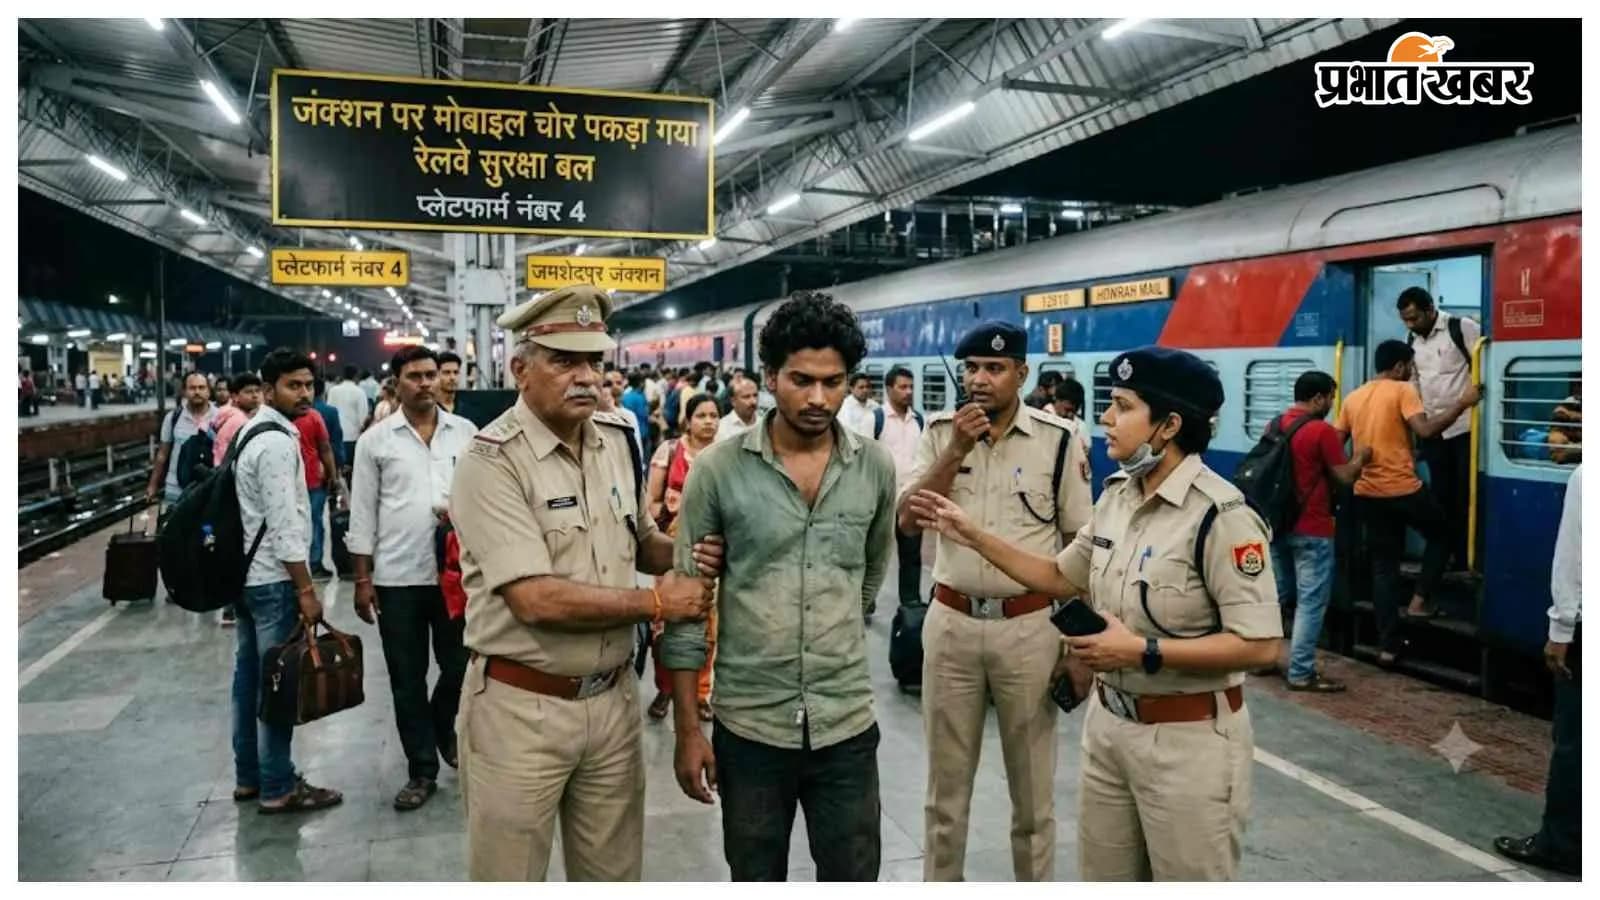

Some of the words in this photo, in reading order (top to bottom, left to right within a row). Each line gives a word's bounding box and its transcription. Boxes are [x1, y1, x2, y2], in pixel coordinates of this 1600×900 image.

[291, 89, 384, 129] जंक्शन
[390, 102, 426, 131] पर
[432, 95, 527, 140] मोबाइल
[533, 101, 577, 139] चोर
[584, 114, 649, 150] पकड़ा
[656, 118, 699, 147] गया
[413, 135, 471, 176] रेलवे
[478, 149, 548, 188] सुरक्षा
[554, 153, 595, 181] बल
[416, 188, 510, 220] प्लेटफार्म
[516, 194, 563, 222] नंबर
[569, 200, 587, 223] 4
[277, 252, 345, 276] प्लेटफार्म
[391, 260, 403, 278] 4
[531, 260, 604, 285] जमशेदपुर
